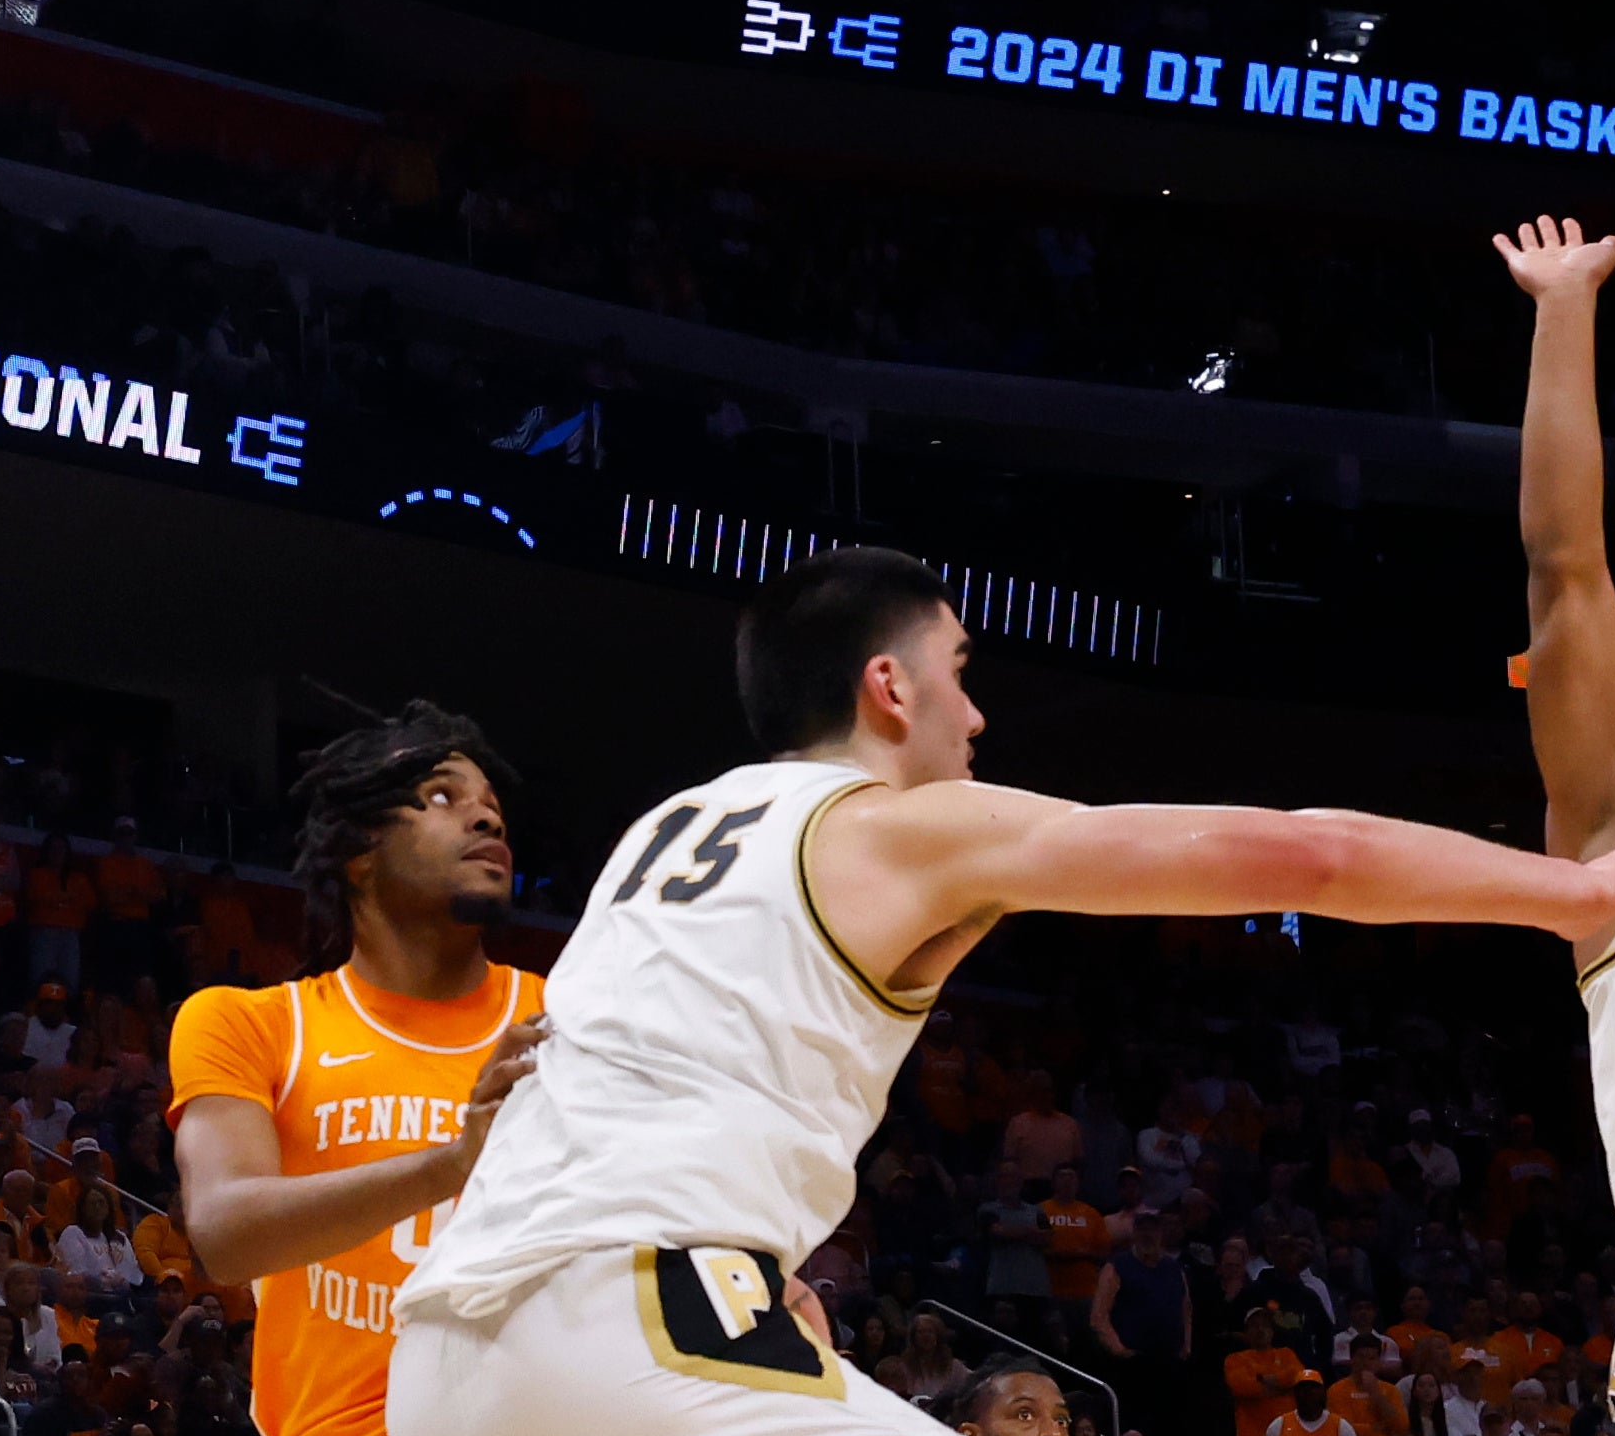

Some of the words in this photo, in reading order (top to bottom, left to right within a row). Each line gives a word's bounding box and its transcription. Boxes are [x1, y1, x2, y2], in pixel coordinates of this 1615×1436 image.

[947, 26, 1123, 96] 2024
[1243, 62, 1438, 134] MEN'S
[611, 801, 773, 907] 15
